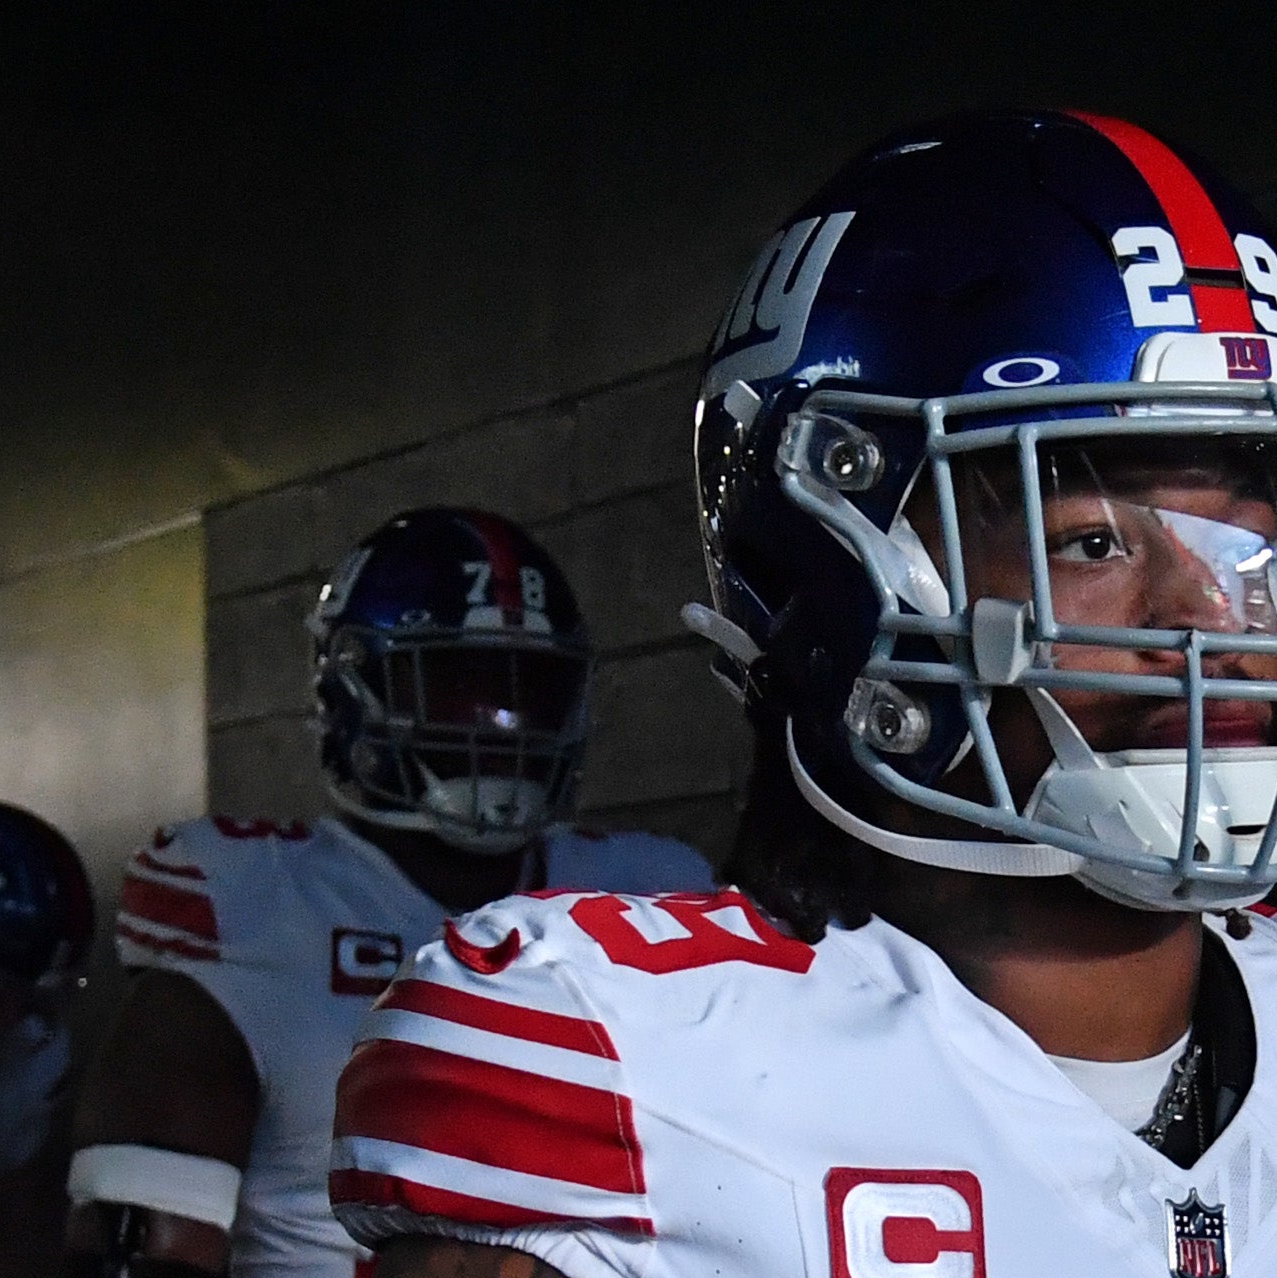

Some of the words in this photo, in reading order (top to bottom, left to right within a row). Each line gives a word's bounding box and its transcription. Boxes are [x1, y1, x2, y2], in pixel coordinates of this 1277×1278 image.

[461, 560, 547, 609] 78
[337, 936, 398, 977] C
[1176, 1238, 1222, 1278] NFL
